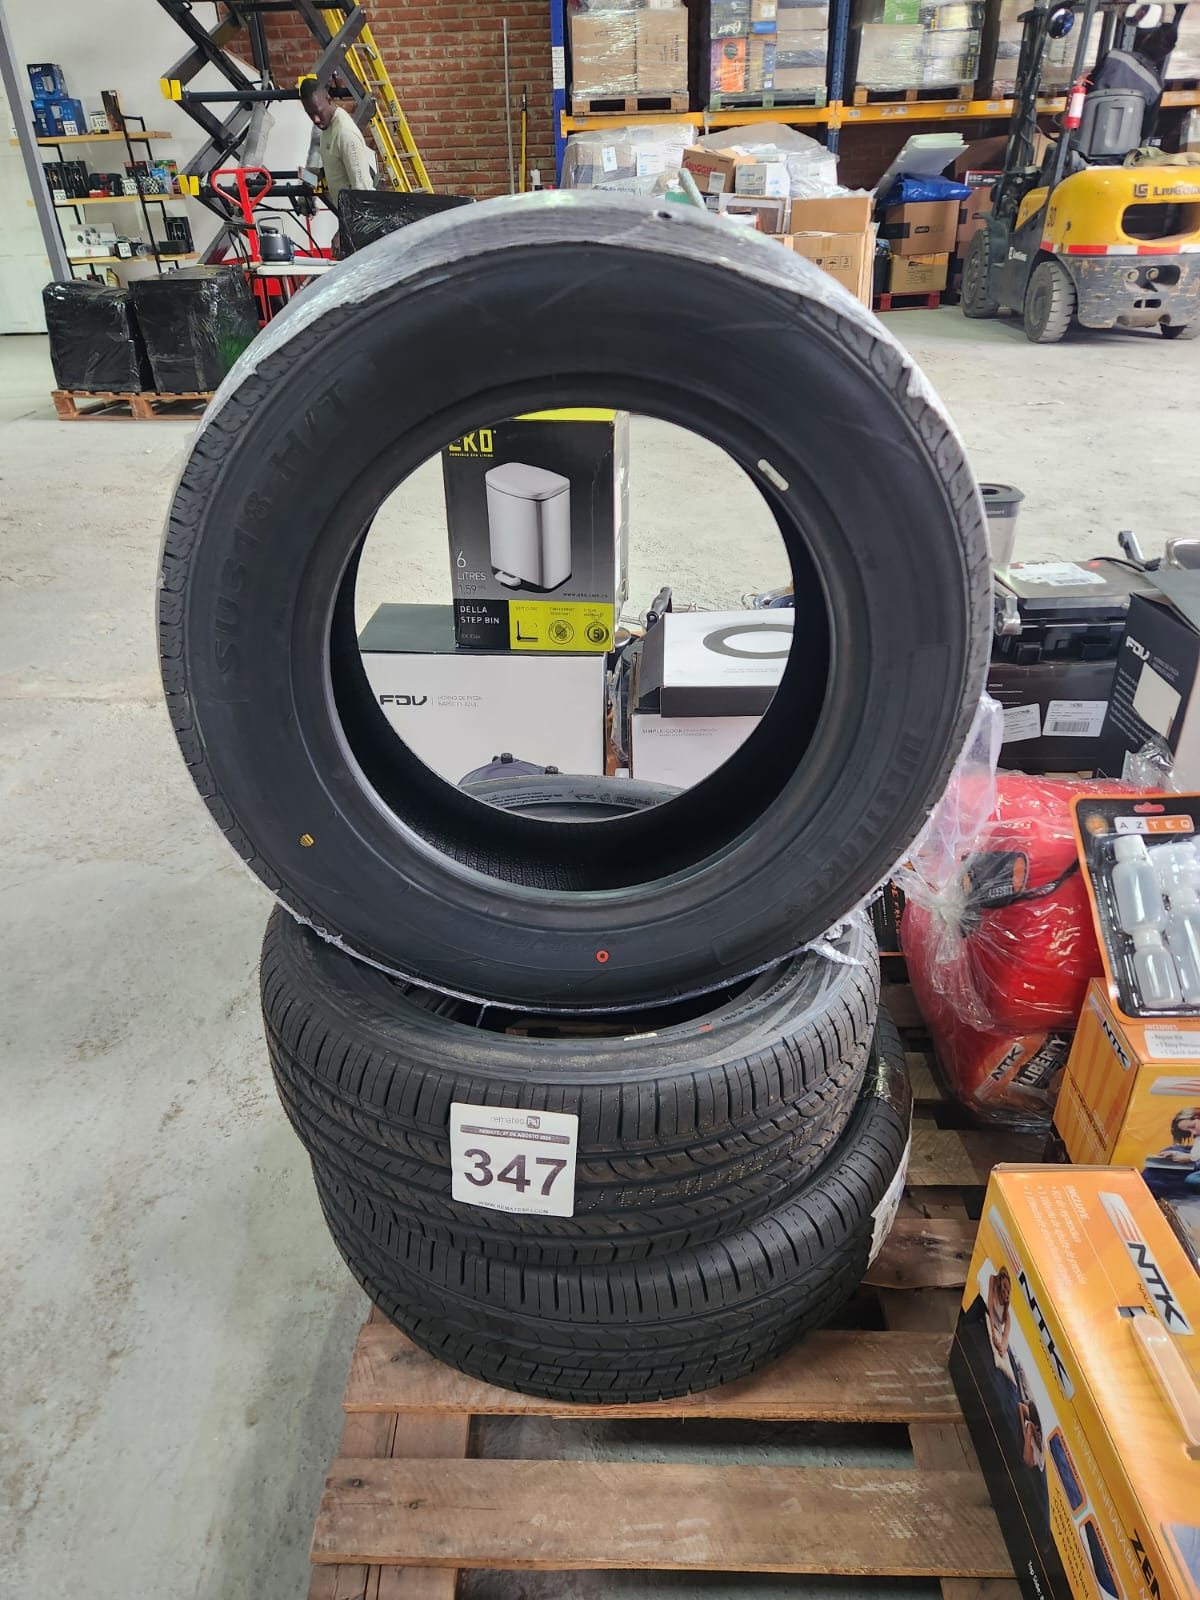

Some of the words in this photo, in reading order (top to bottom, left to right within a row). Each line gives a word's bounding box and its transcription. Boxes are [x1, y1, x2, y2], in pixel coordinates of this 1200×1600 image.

[456, 550, 467, 568] 6
[457, 571, 486, 581] LITRES
[460, 605, 488, 613] DELLA
[1126, 635, 1150, 661] FDV
[379, 694, 428, 706] FDV
[1020, 1034, 1068, 1086] LIBERTY
[1102, 1020, 1129, 1069] NTK
[991, 1045, 1021, 1082] NTK
[463, 1148, 568, 1197] 347
[1127, 1242, 1191, 1331] NTK
[1017, 1271, 1073, 1390] NTK
